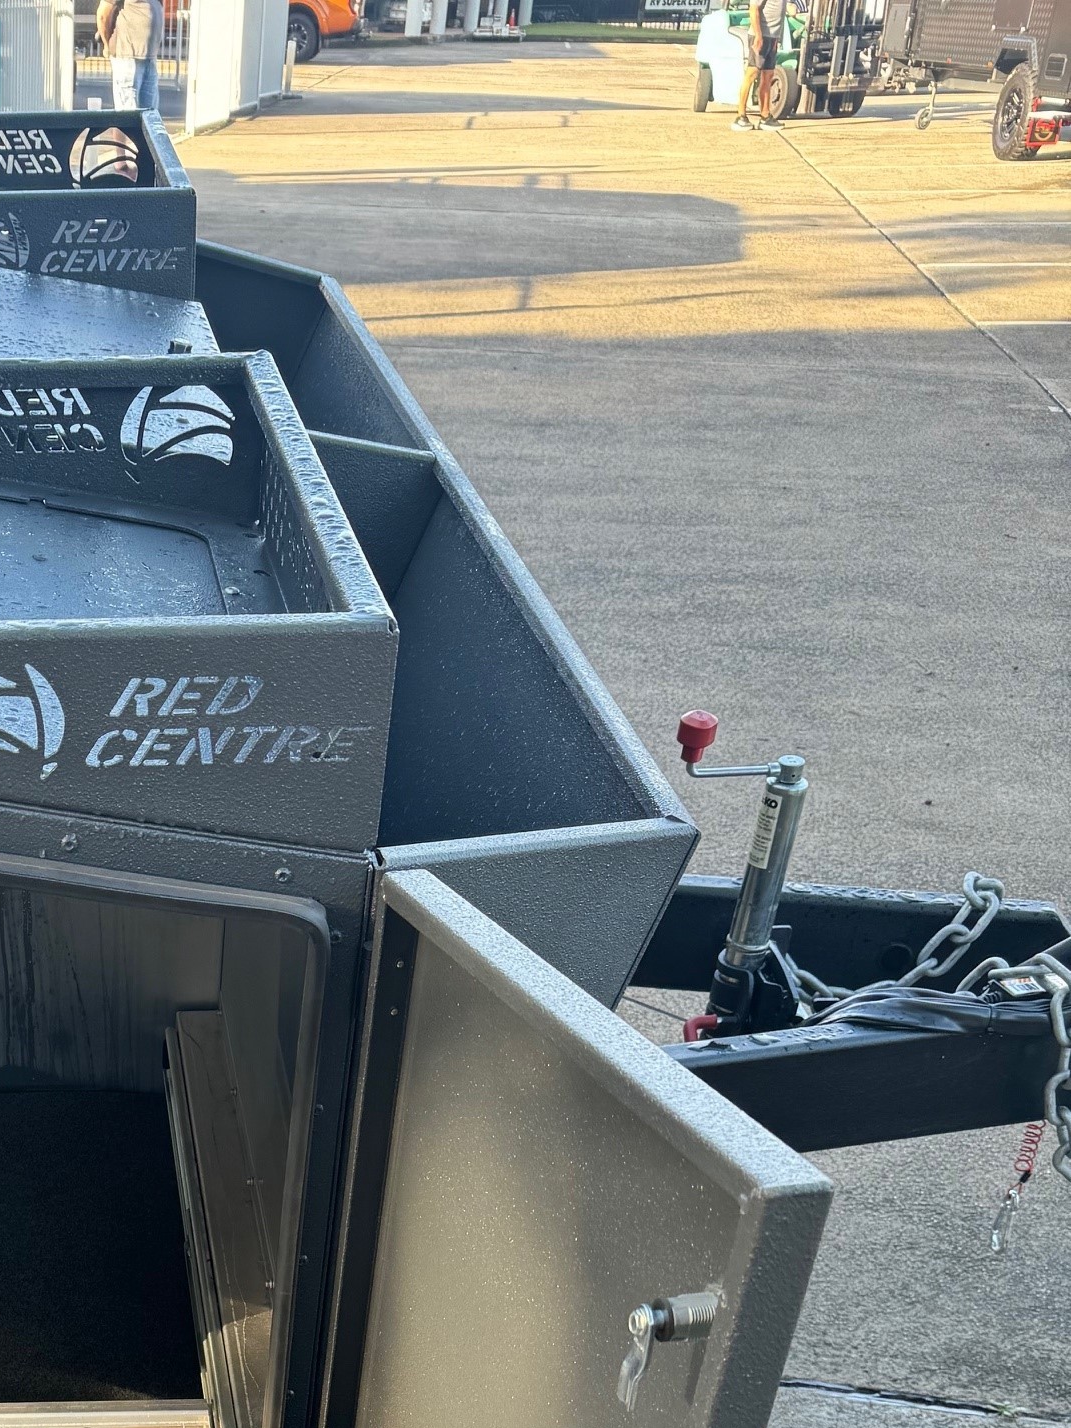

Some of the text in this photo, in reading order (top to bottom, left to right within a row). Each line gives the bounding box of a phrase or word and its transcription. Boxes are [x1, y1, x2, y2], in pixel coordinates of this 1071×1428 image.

[52, 219, 130, 243] RED
[40, 247, 186, 272] CENTRE
[109, 675, 264, 717] RED
[85, 726, 374, 767] CENTRE
